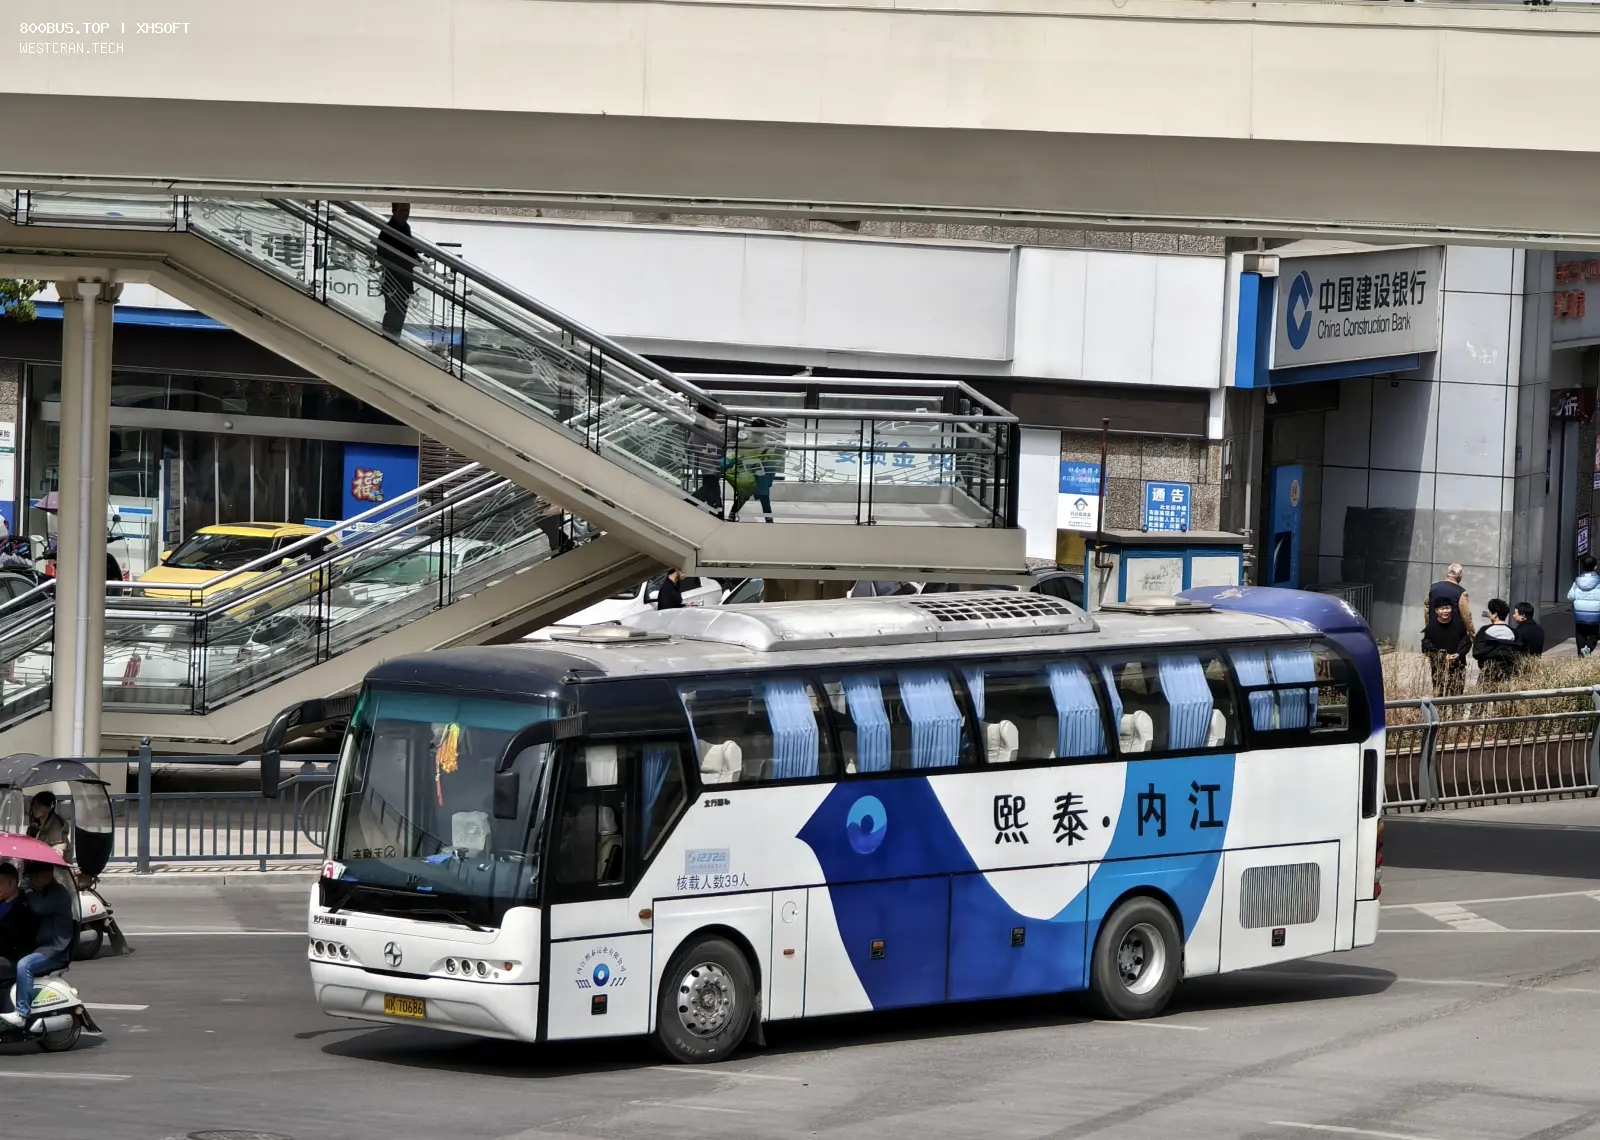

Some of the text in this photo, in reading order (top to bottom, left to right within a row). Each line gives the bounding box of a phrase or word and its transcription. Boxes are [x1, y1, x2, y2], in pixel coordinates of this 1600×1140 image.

[1318, 270, 1427, 314] 中国建设银行
[1317, 311, 1411, 340] China Construction Bank
[1152, 487, 1185, 503] 通告
[676, 872, 749, 891] 核载人数39人
